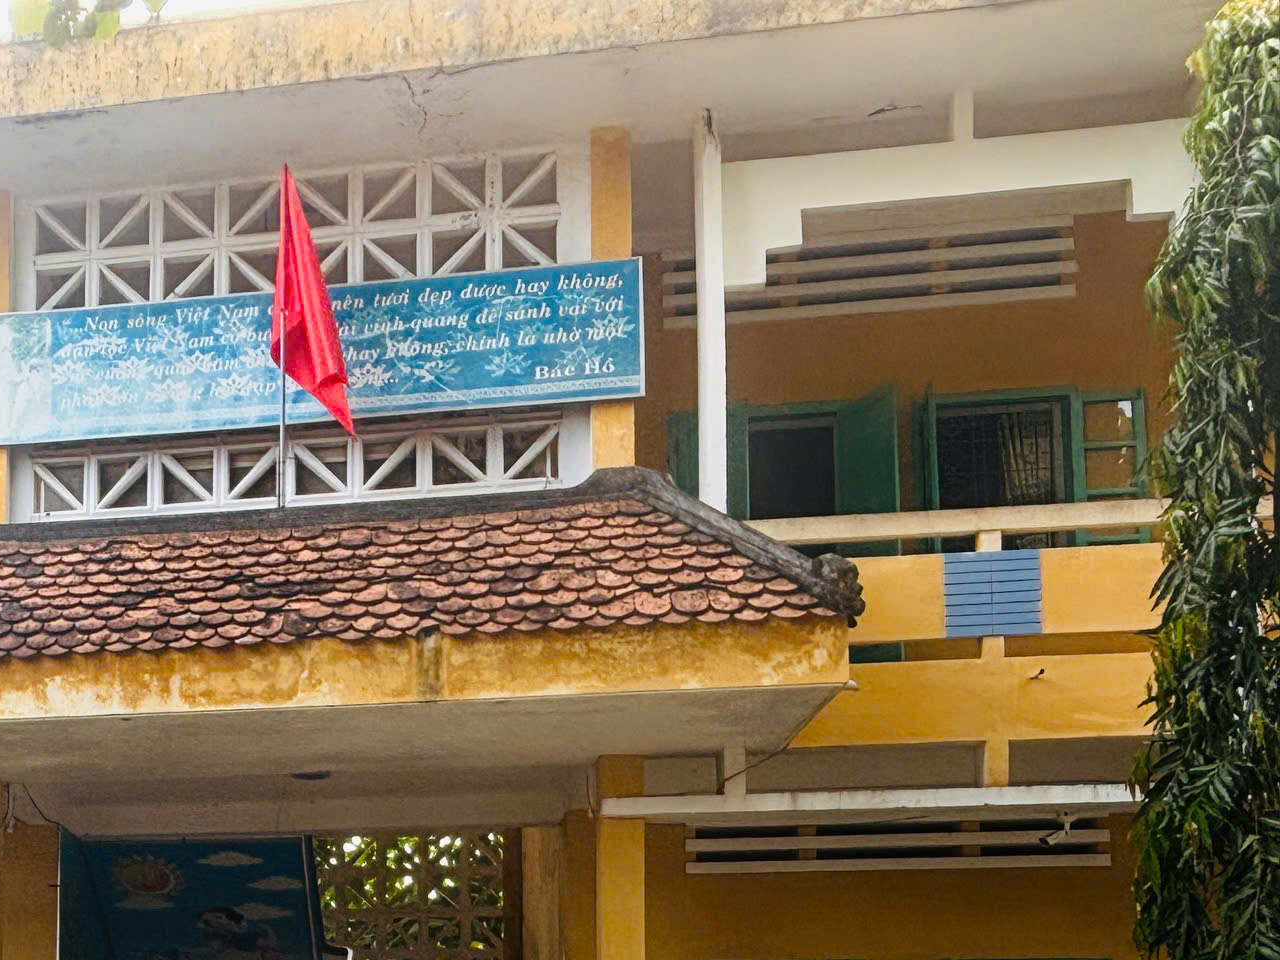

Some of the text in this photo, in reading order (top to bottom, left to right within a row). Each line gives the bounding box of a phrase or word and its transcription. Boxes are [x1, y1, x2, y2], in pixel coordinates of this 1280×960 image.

[175, 306, 210, 324] Việt
[220, 304, 259, 318] Nam
[374, 288, 410, 308] tươi
[515, 279, 549, 295] hay
[557, 273, 624, 290] không,
[411, 313, 470, 332] quang
[595, 294, 624, 312] với
[456, 333, 510, 351] chính
[543, 326, 582, 344] nhờ
